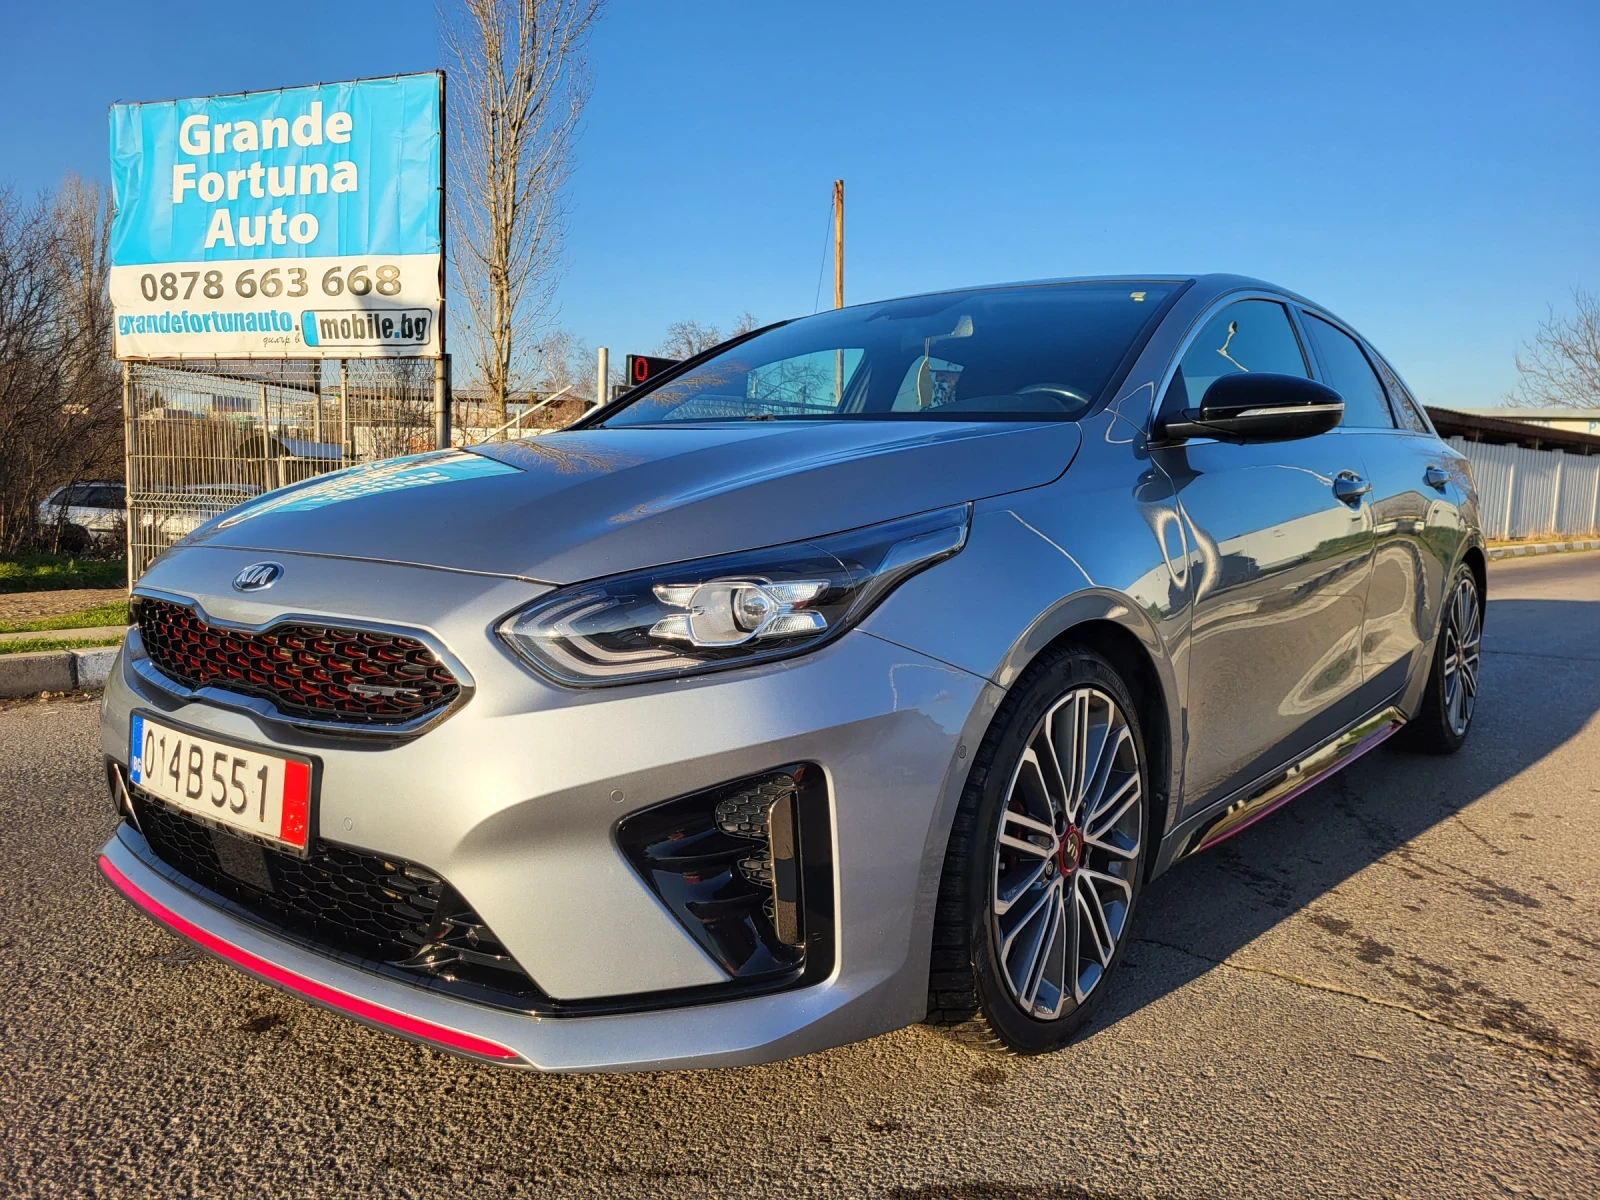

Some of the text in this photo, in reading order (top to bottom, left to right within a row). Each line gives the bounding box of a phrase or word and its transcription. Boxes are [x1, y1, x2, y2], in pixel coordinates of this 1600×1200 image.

[179, 101, 353, 156] Grande
[172, 160, 358, 203] Fortuna
[204, 207, 319, 248] Auto
[140, 264, 402, 301] 0878 663 668
[319, 313, 428, 341] mobile.bg
[634, 357, 648, 381] 0
[236, 565, 274, 585] KIA
[133, 756, 142, 773] BG
[144, 729, 269, 822] 014B551
